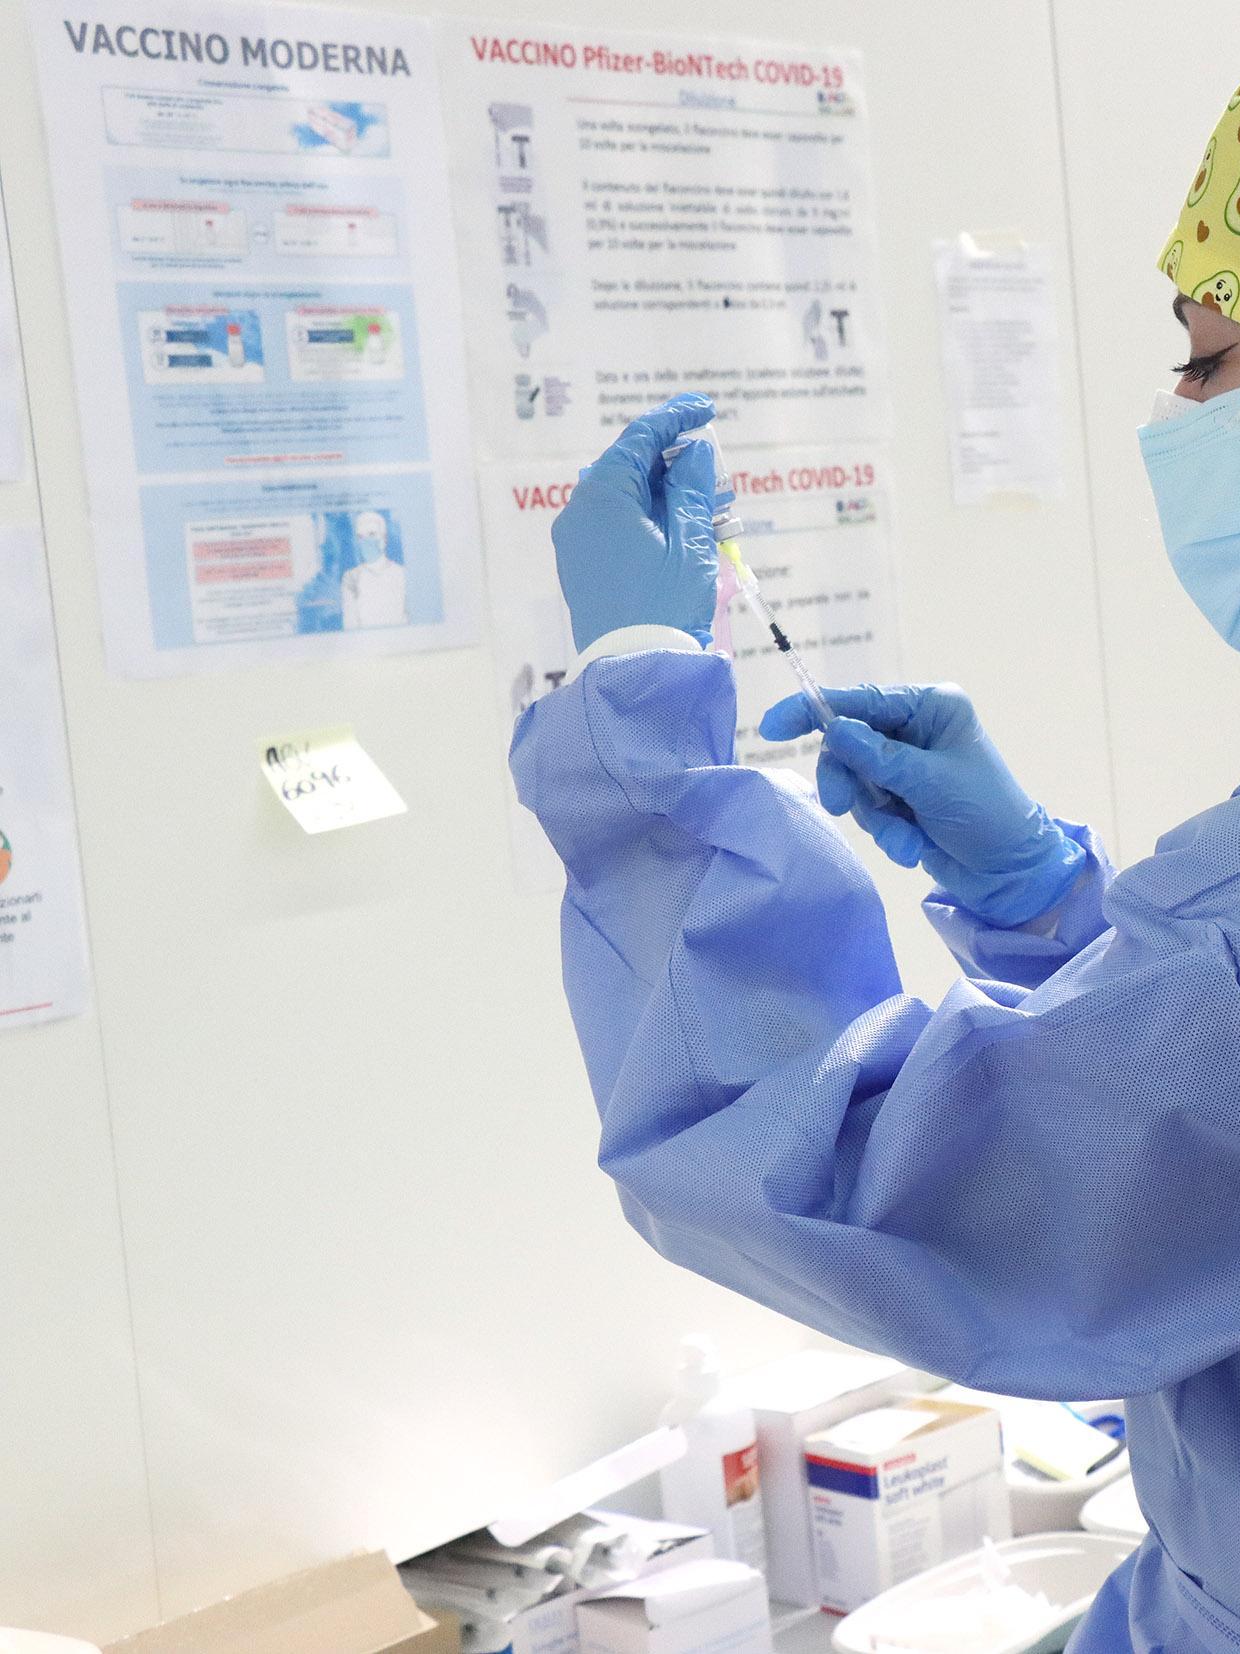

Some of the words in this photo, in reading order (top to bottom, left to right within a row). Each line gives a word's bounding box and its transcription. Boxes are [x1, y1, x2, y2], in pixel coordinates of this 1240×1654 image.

[64, 20, 230, 65] VACCINO
[240, 36, 412, 77] MODERNA
[471, 36, 577, 68] VACCINO
[582, 45, 749, 80] Pfizer-BioNTech
[754, 59, 843, 88] COVID-19
[512, 483, 576, 512] VACC
[788, 463, 875, 491] COVID-19
